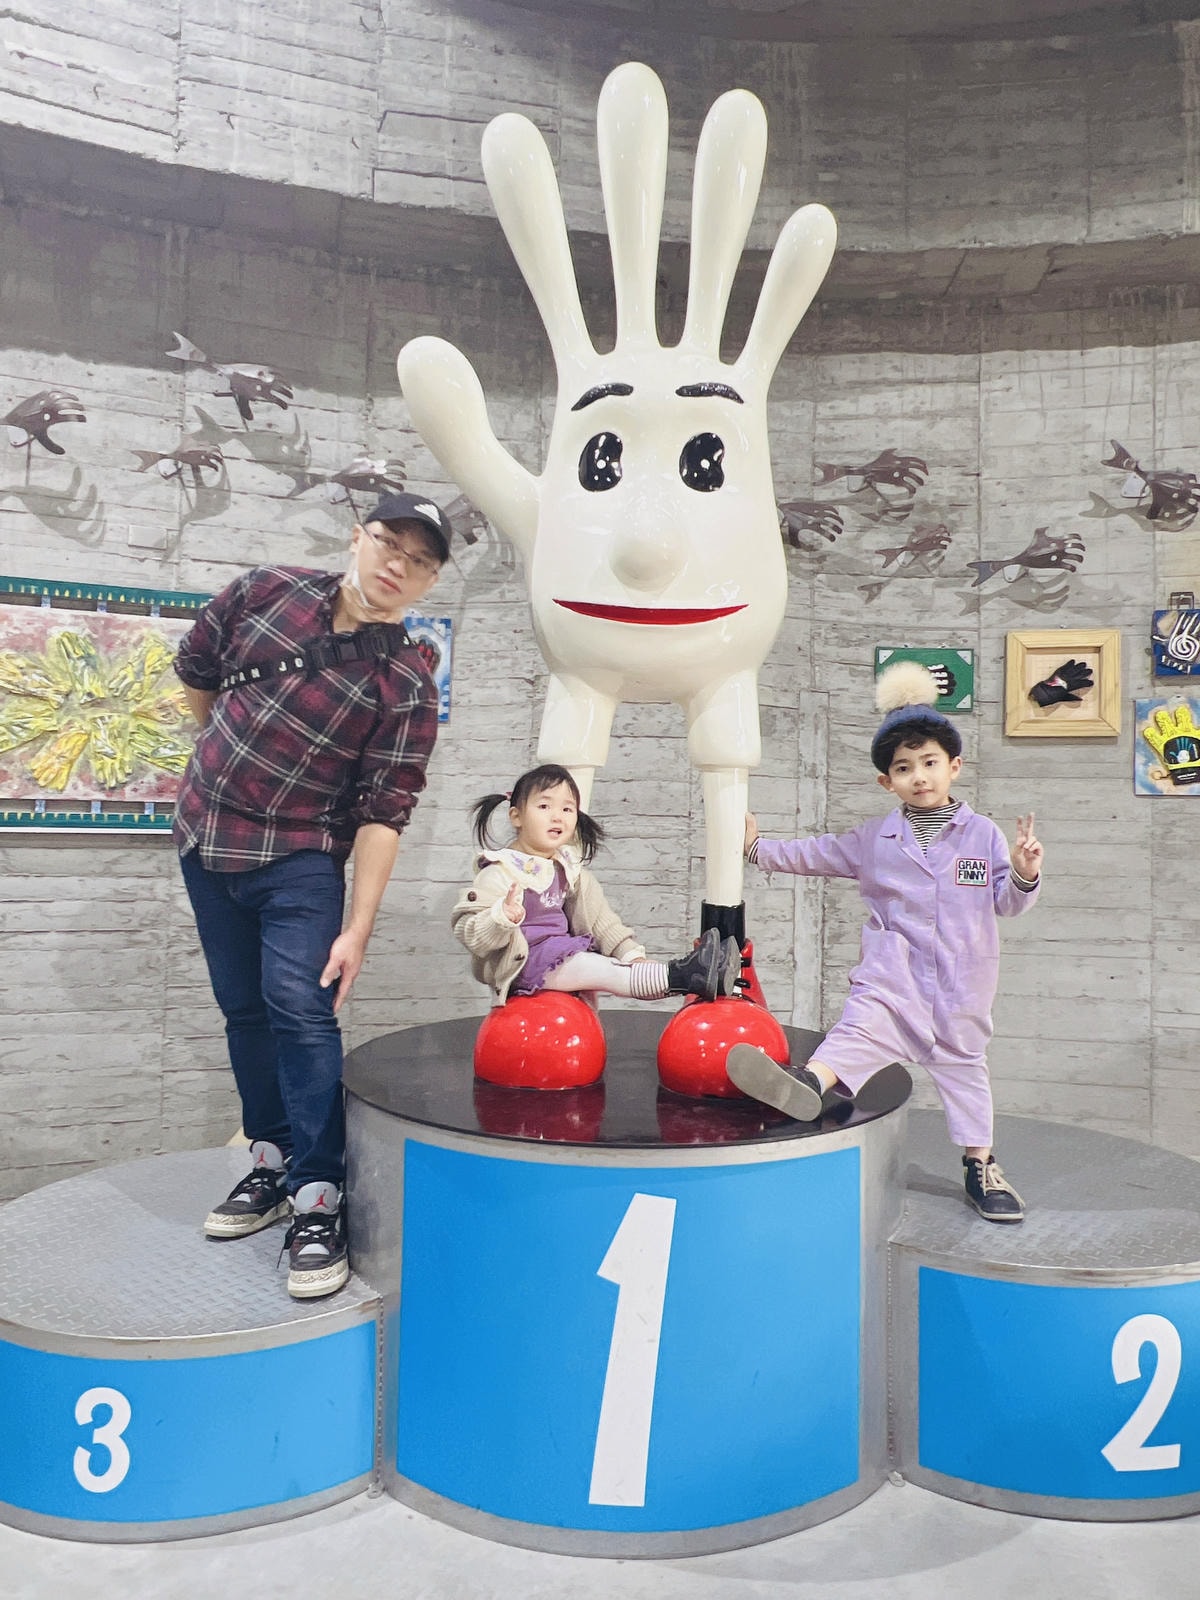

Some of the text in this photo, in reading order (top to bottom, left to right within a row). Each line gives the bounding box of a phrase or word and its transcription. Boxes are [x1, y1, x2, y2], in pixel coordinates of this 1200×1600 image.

[958, 860, 986, 870] GRAN
[958, 870, 986, 880] FINNY
[588, 1193, 677, 1507] 1
[1101, 1314, 1182, 1471] 2
[73, 1387, 131, 1493] 3
